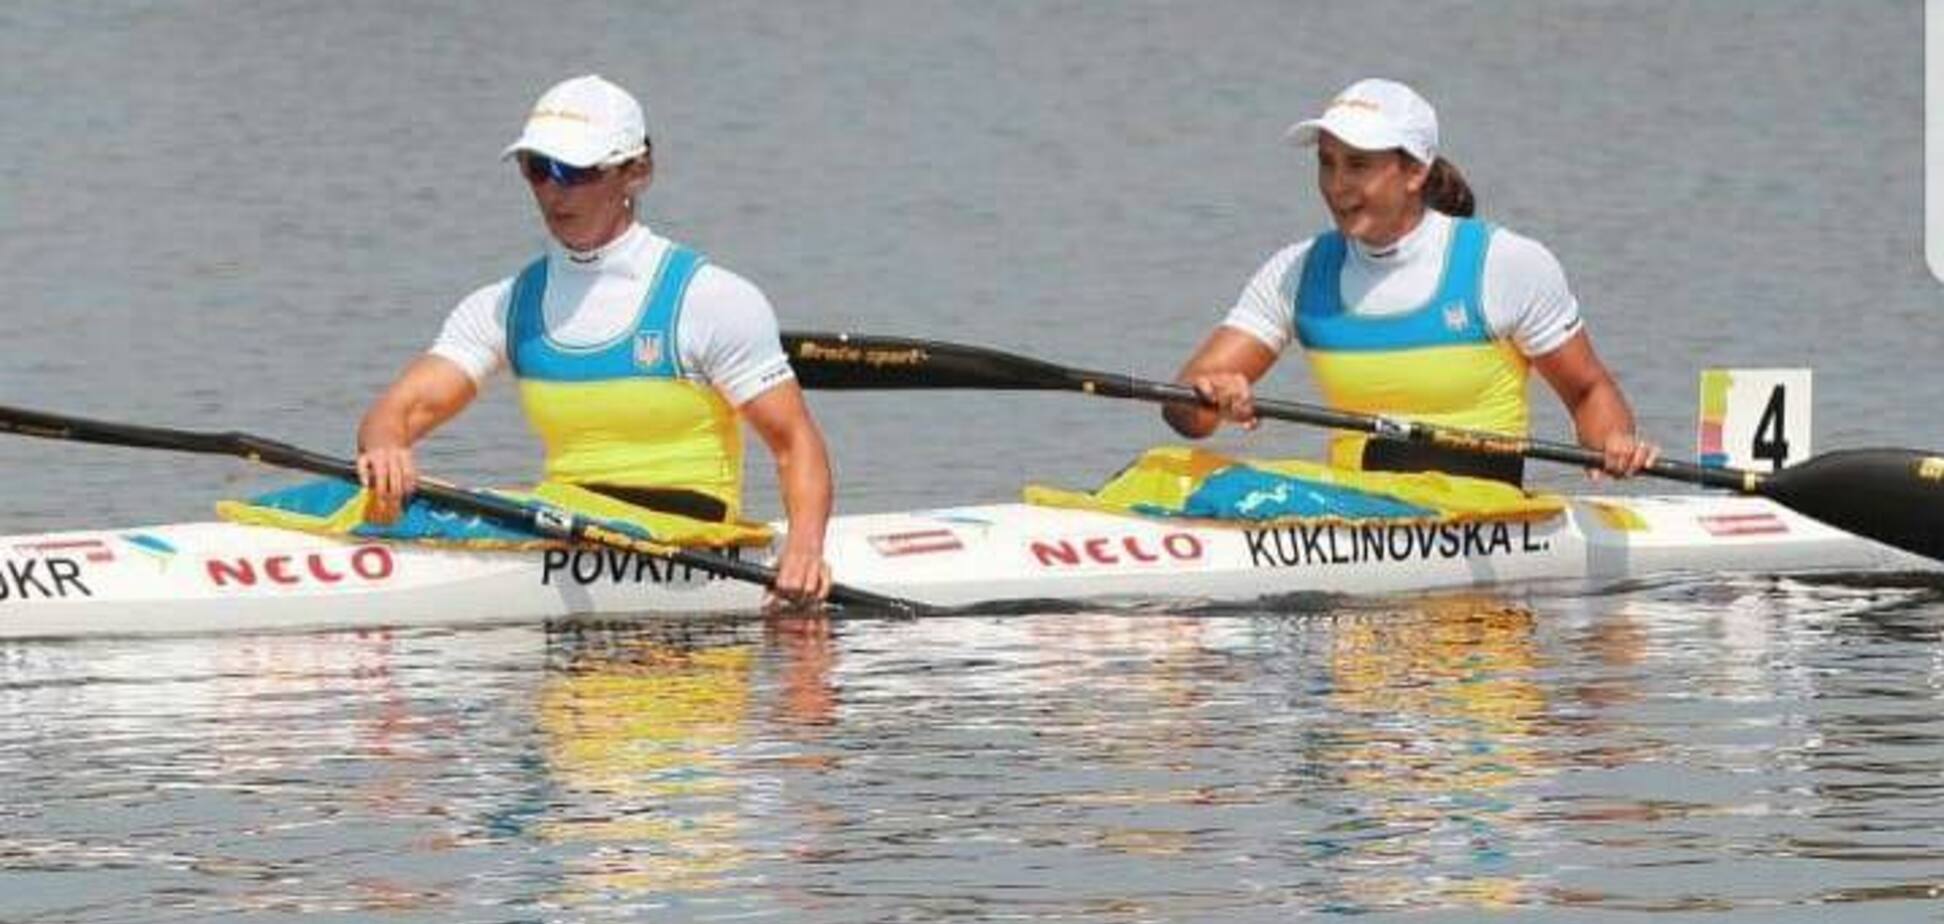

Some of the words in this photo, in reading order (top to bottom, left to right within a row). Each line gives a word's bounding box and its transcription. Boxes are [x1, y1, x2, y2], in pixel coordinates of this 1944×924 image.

[1752, 383, 1789, 470] 4
[1245, 521, 1512, 566] KUKLINOVSKA
[1523, 521, 1550, 551] L.
